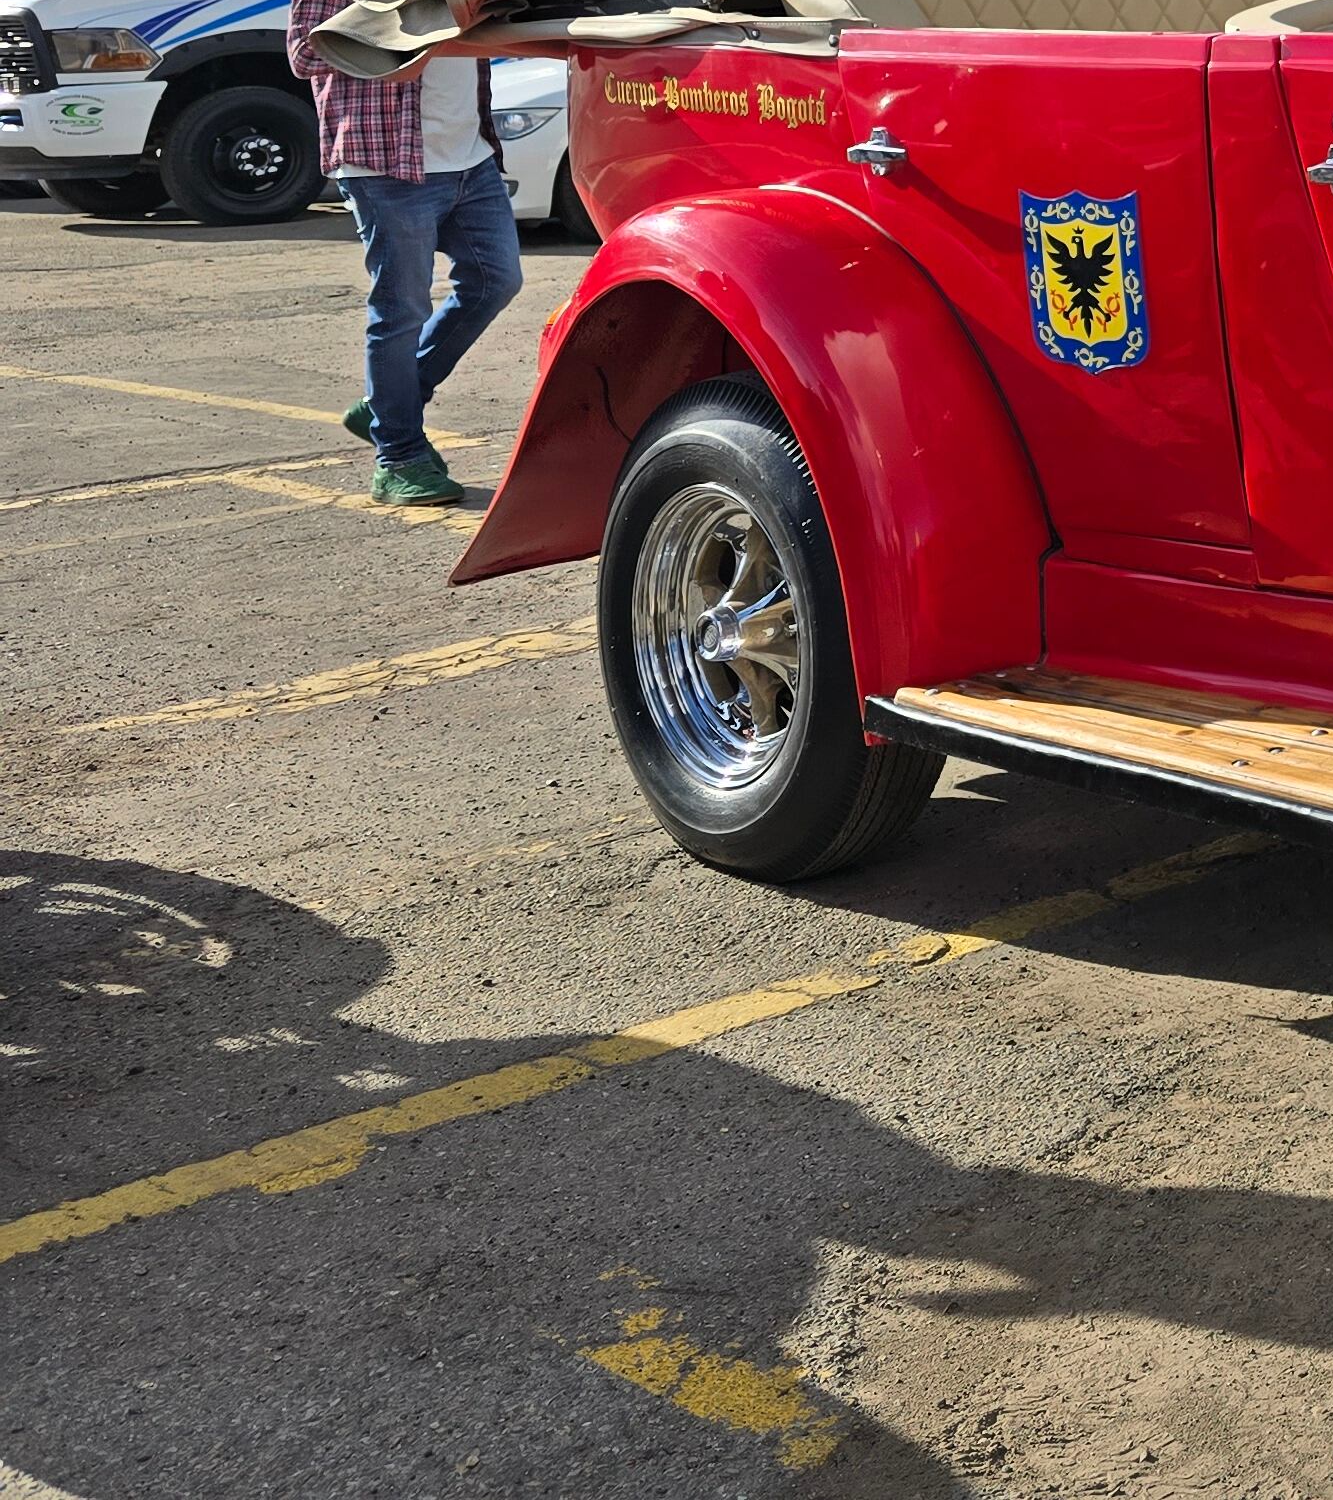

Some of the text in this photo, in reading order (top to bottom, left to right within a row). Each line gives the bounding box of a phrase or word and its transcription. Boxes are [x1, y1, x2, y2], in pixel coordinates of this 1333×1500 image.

[604, 71, 827, 130] Cuerpo Bomberos Bogotá
